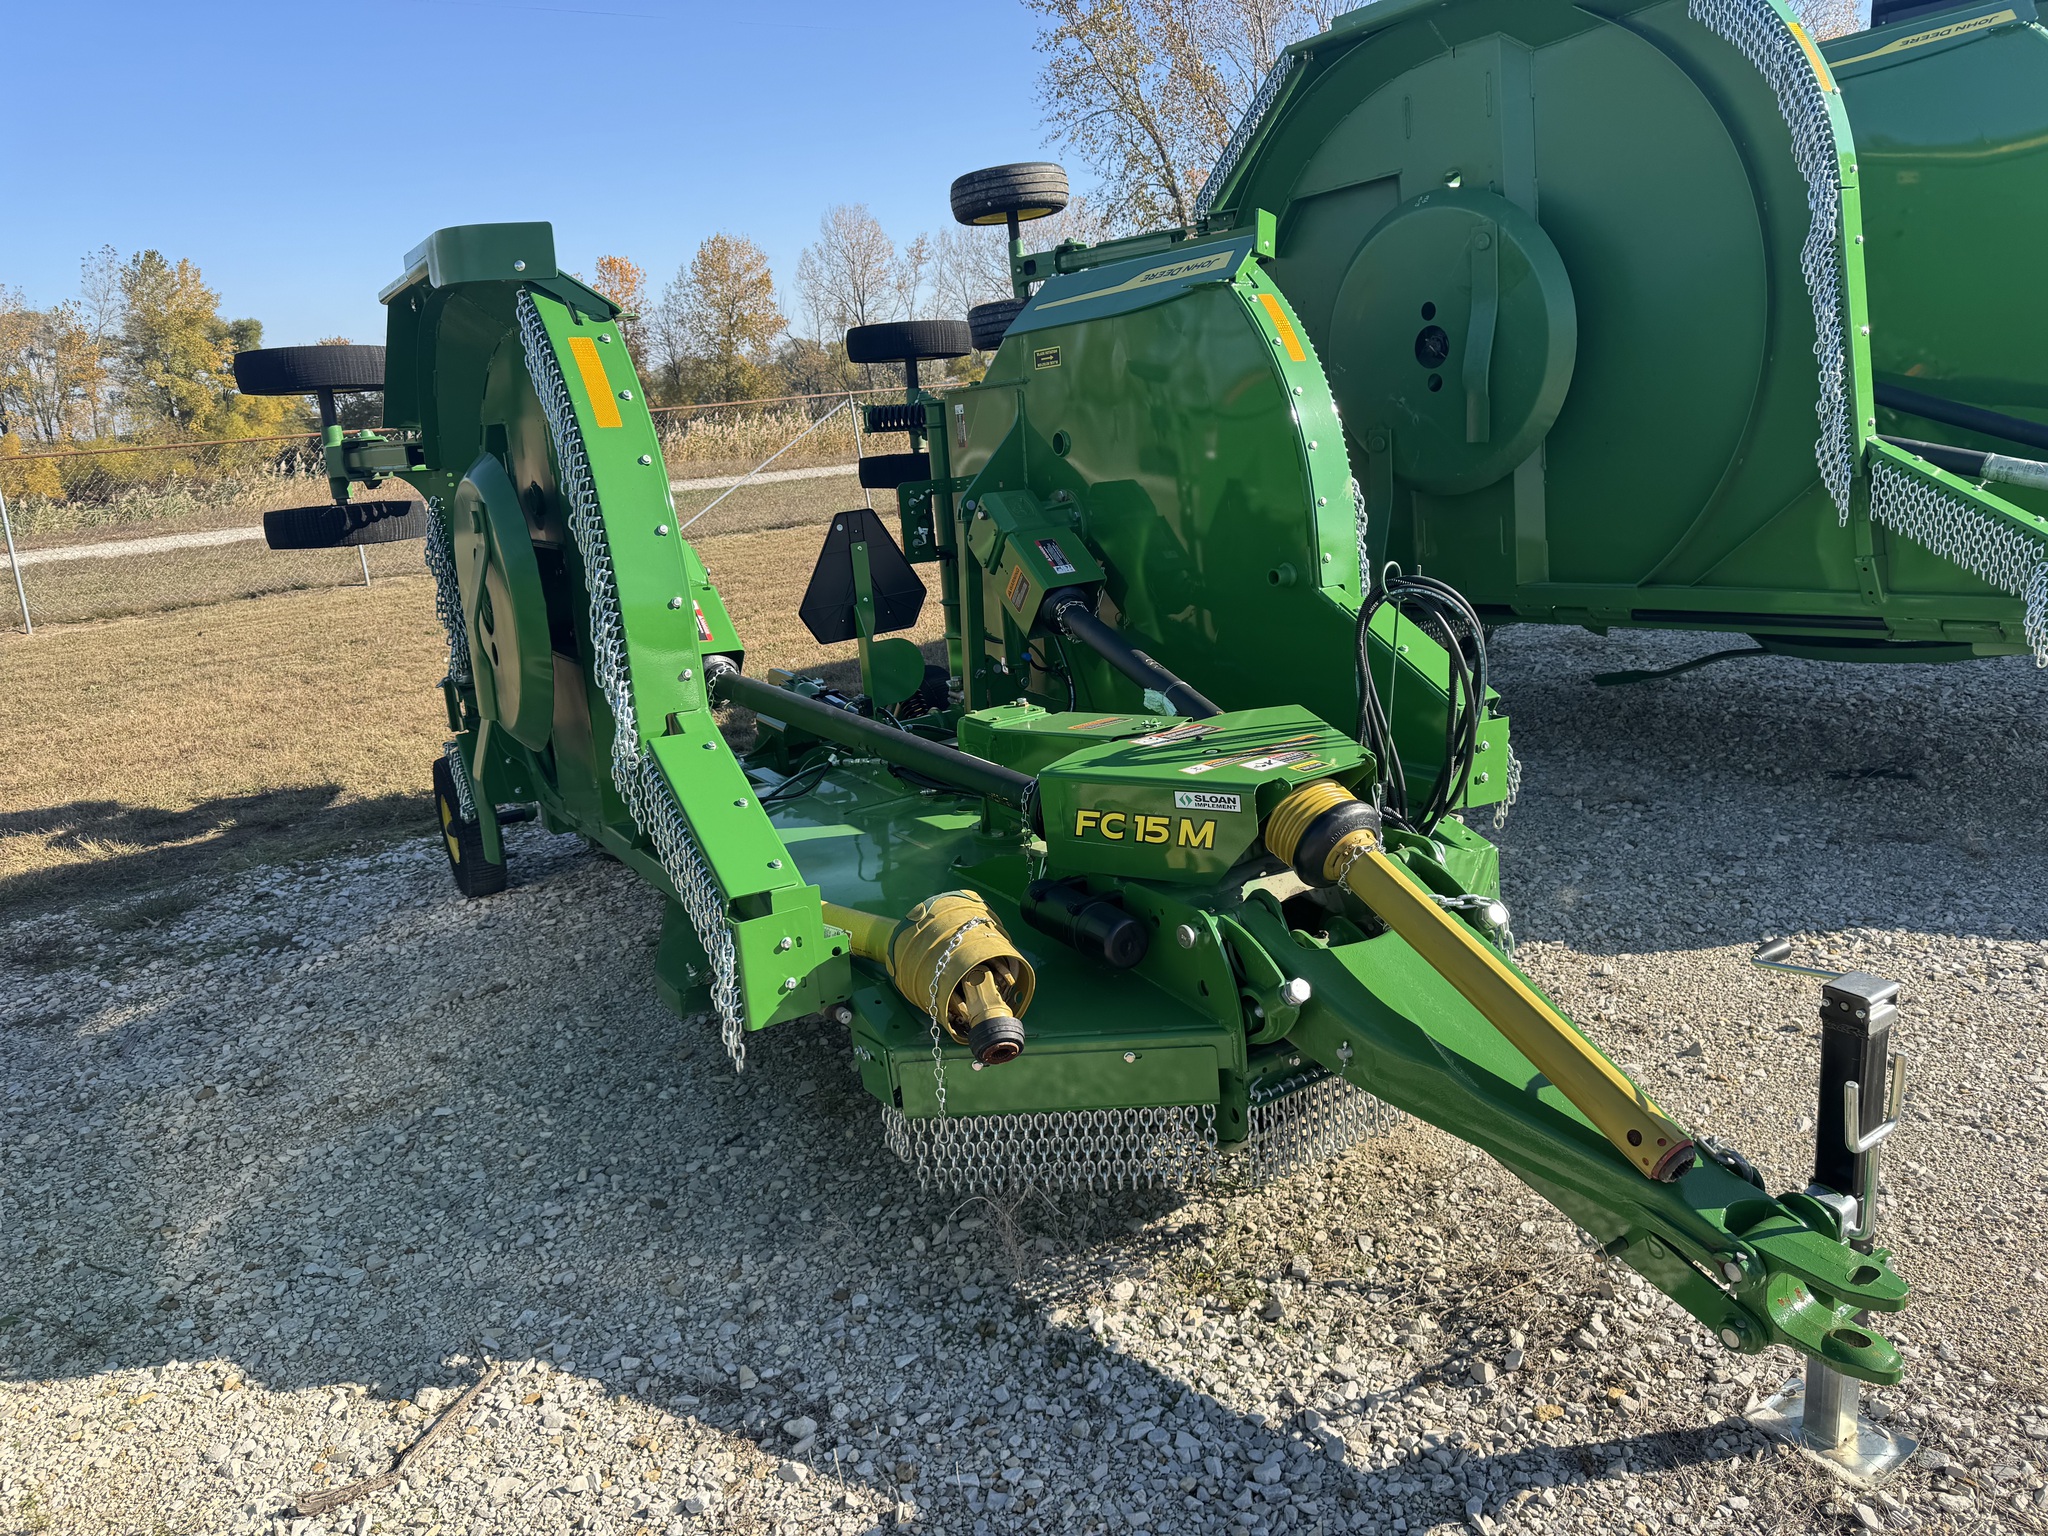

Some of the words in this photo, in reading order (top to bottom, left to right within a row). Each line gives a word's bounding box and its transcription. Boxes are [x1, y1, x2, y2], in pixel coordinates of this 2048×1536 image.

[1955, 15, 1999, 32] JOHN
[1899, 28, 1952, 47] DEERE
[1181, 257, 1221, 273] JOHN
[1140, 266, 1183, 282] DEERE
[1194, 794, 1237, 805] SLOAN
[1194, 802, 1237, 810] IMPLEMENT
[1074, 808, 1126, 841] FC
[1134, 813, 1171, 844] 15
[1177, 817, 1217, 850] M
